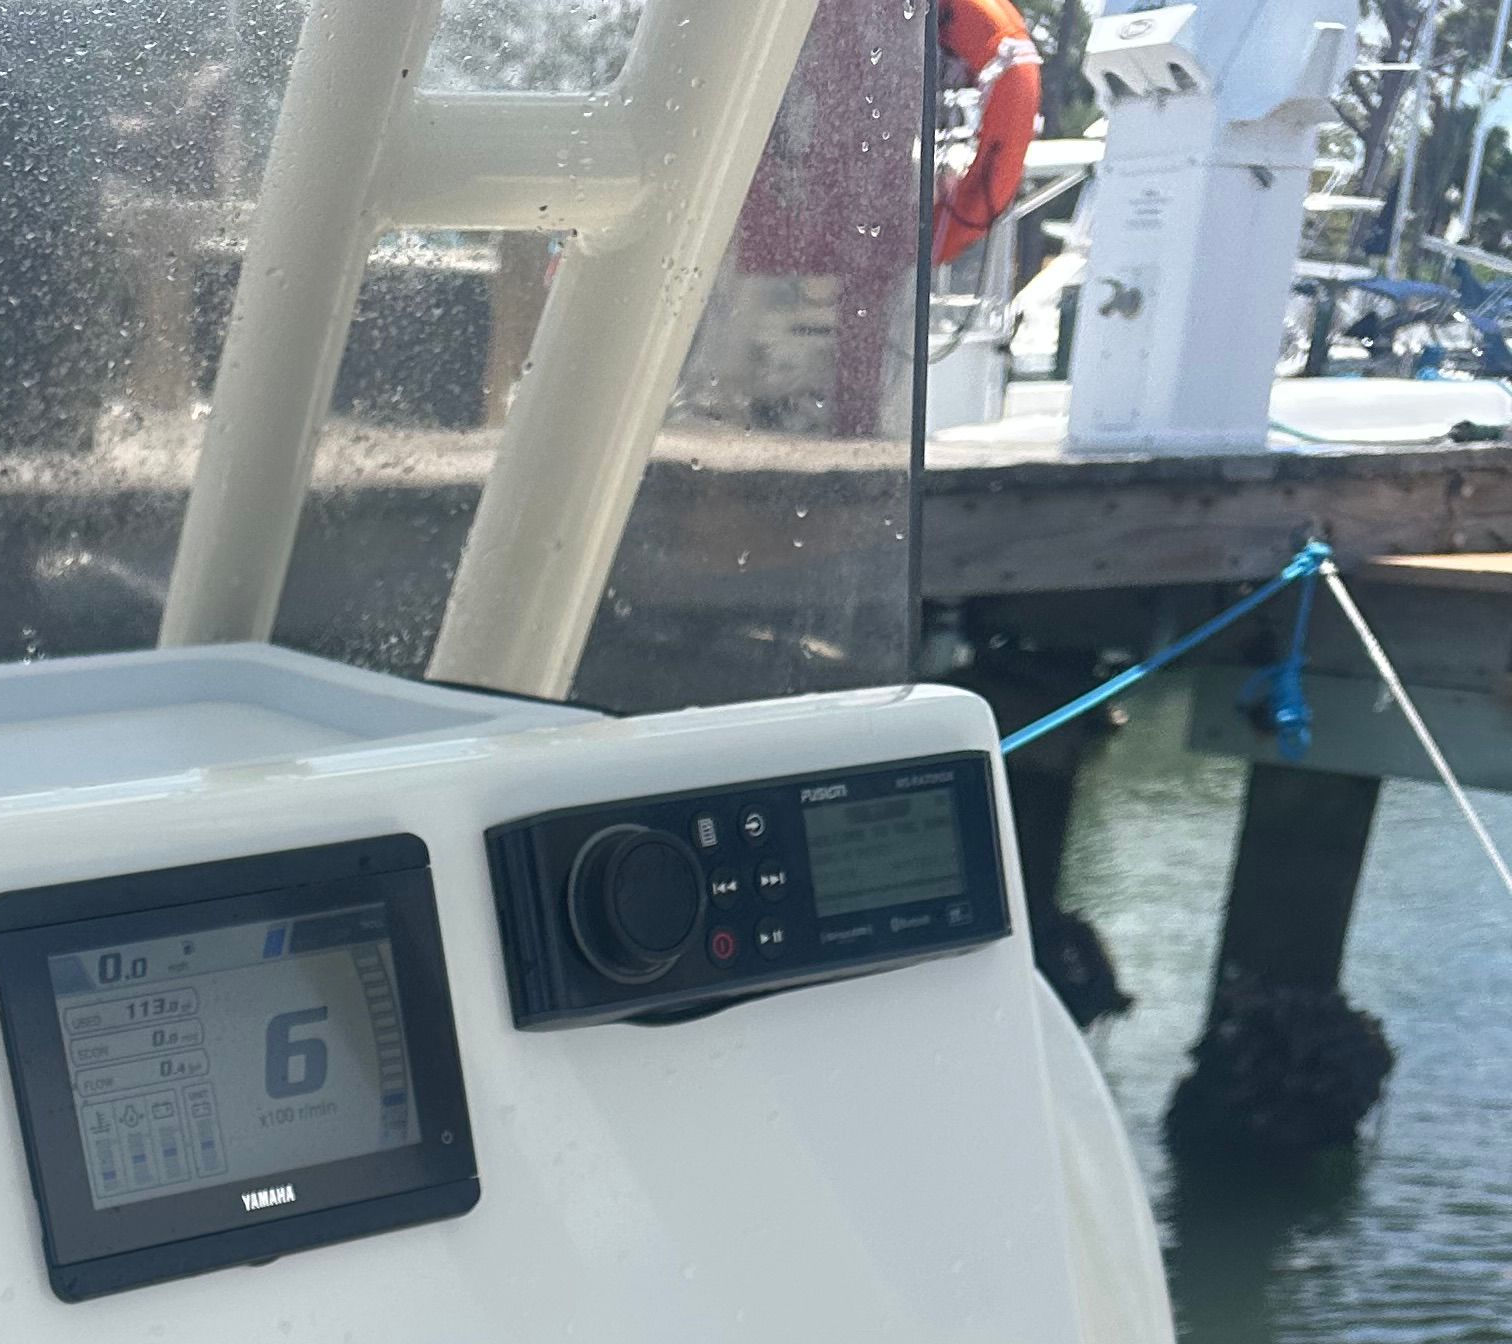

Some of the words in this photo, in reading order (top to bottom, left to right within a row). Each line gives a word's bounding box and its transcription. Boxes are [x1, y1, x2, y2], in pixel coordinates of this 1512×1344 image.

[98, 953, 147, 984] 0.0
[264, 1004, 329, 1100] 6
[241, 1183, 296, 1212] YAMAHA
